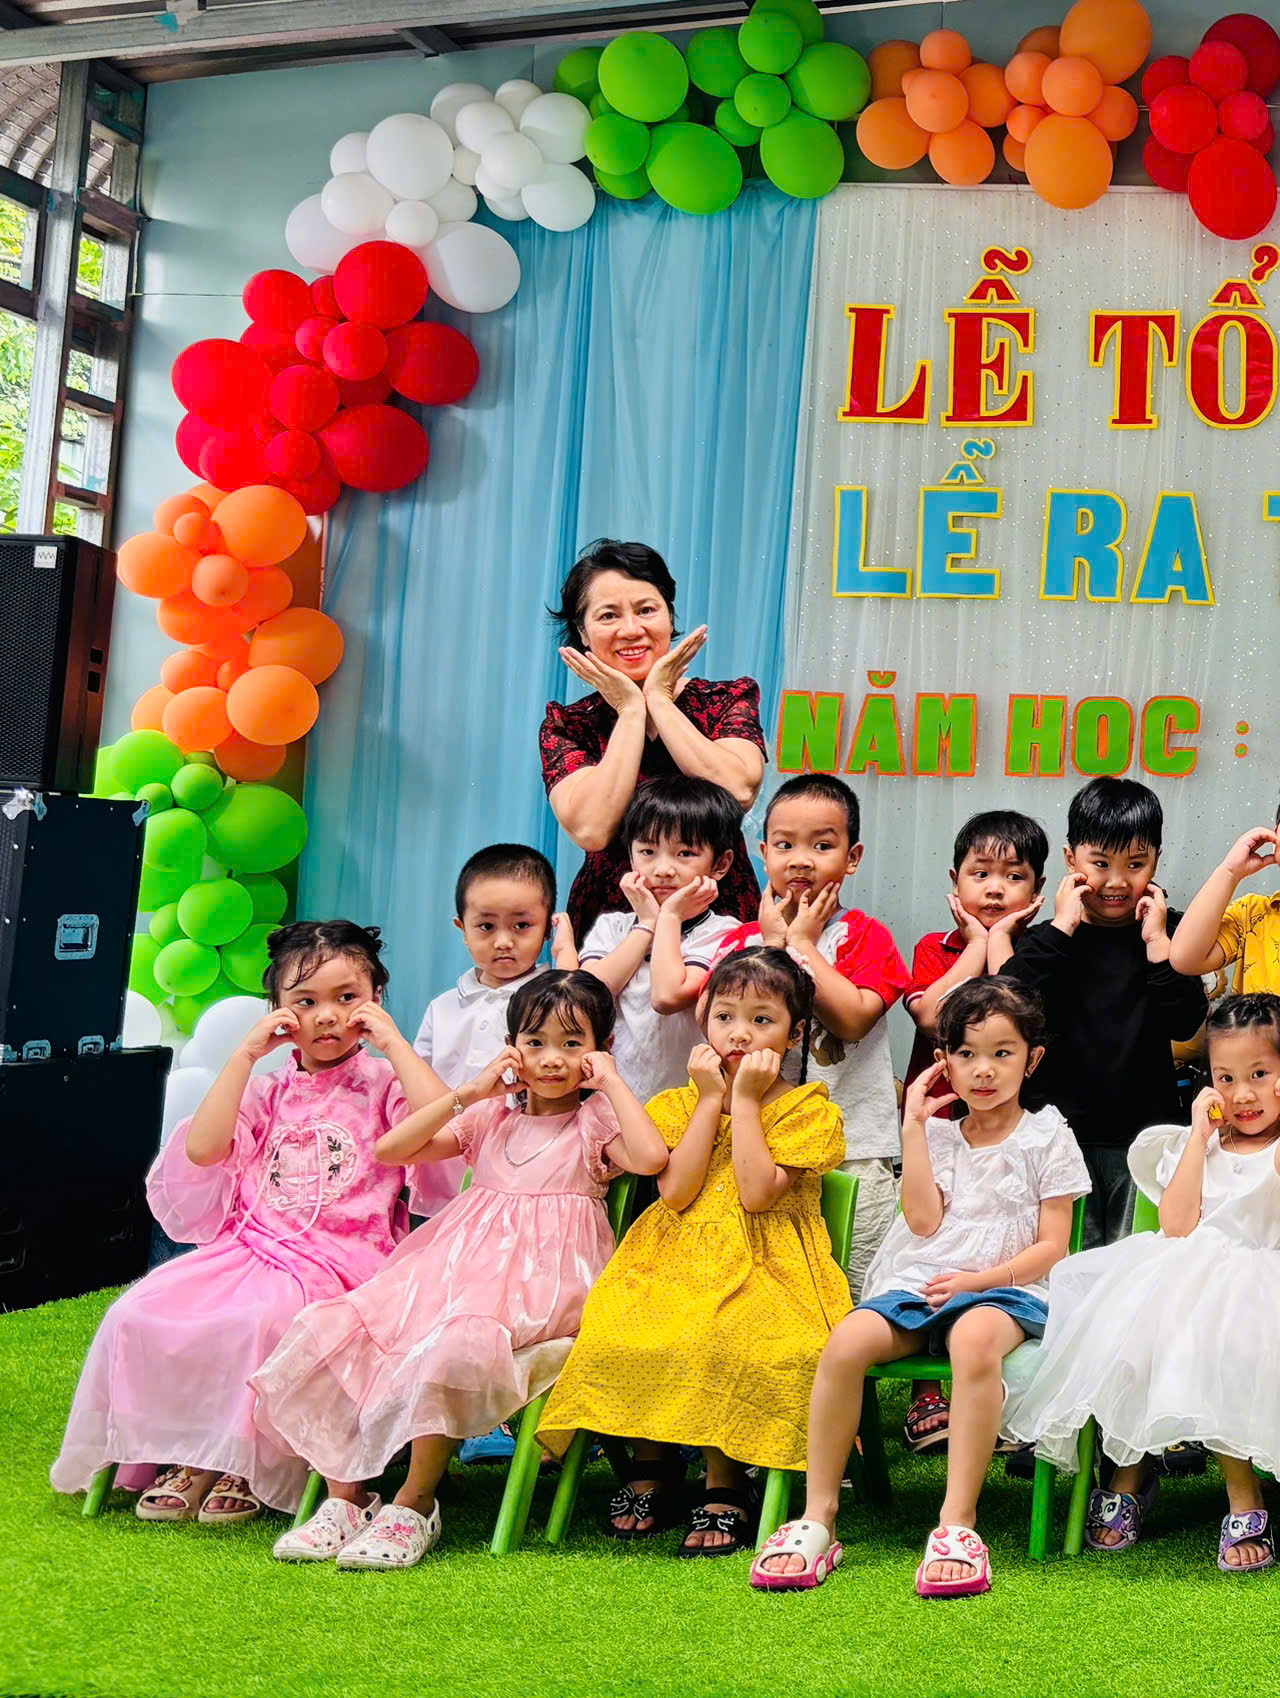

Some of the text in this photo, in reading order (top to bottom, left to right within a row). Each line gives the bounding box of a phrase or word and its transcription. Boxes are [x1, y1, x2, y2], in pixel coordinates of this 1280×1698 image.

[837, 245, 1037, 429] LỄ
[832, 438, 1004, 600] LỄ
[1040, 488, 1216, 606] RA
[775, 670, 979, 778] NĂM
